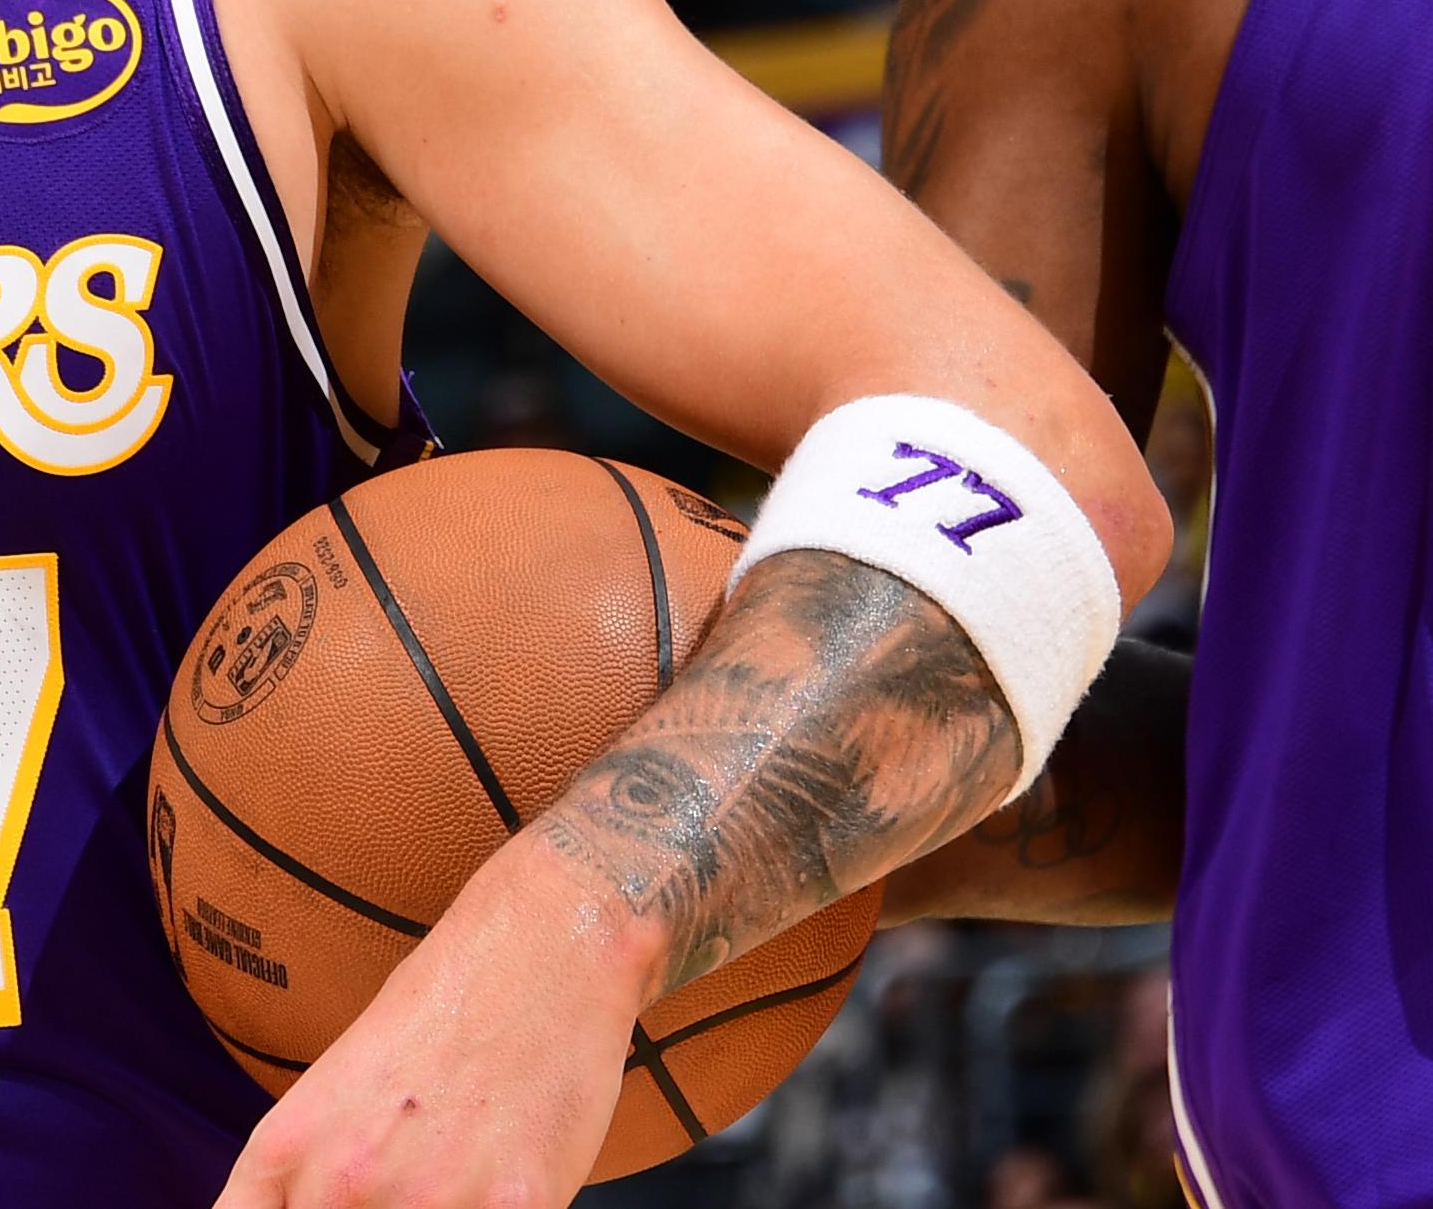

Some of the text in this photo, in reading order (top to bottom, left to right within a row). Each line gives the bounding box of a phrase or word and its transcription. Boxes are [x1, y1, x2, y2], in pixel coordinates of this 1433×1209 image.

[856, 442, 1024, 556] 77
[203, 926, 233, 966] GAME
[232, 943, 289, 990] OFFICIAL
